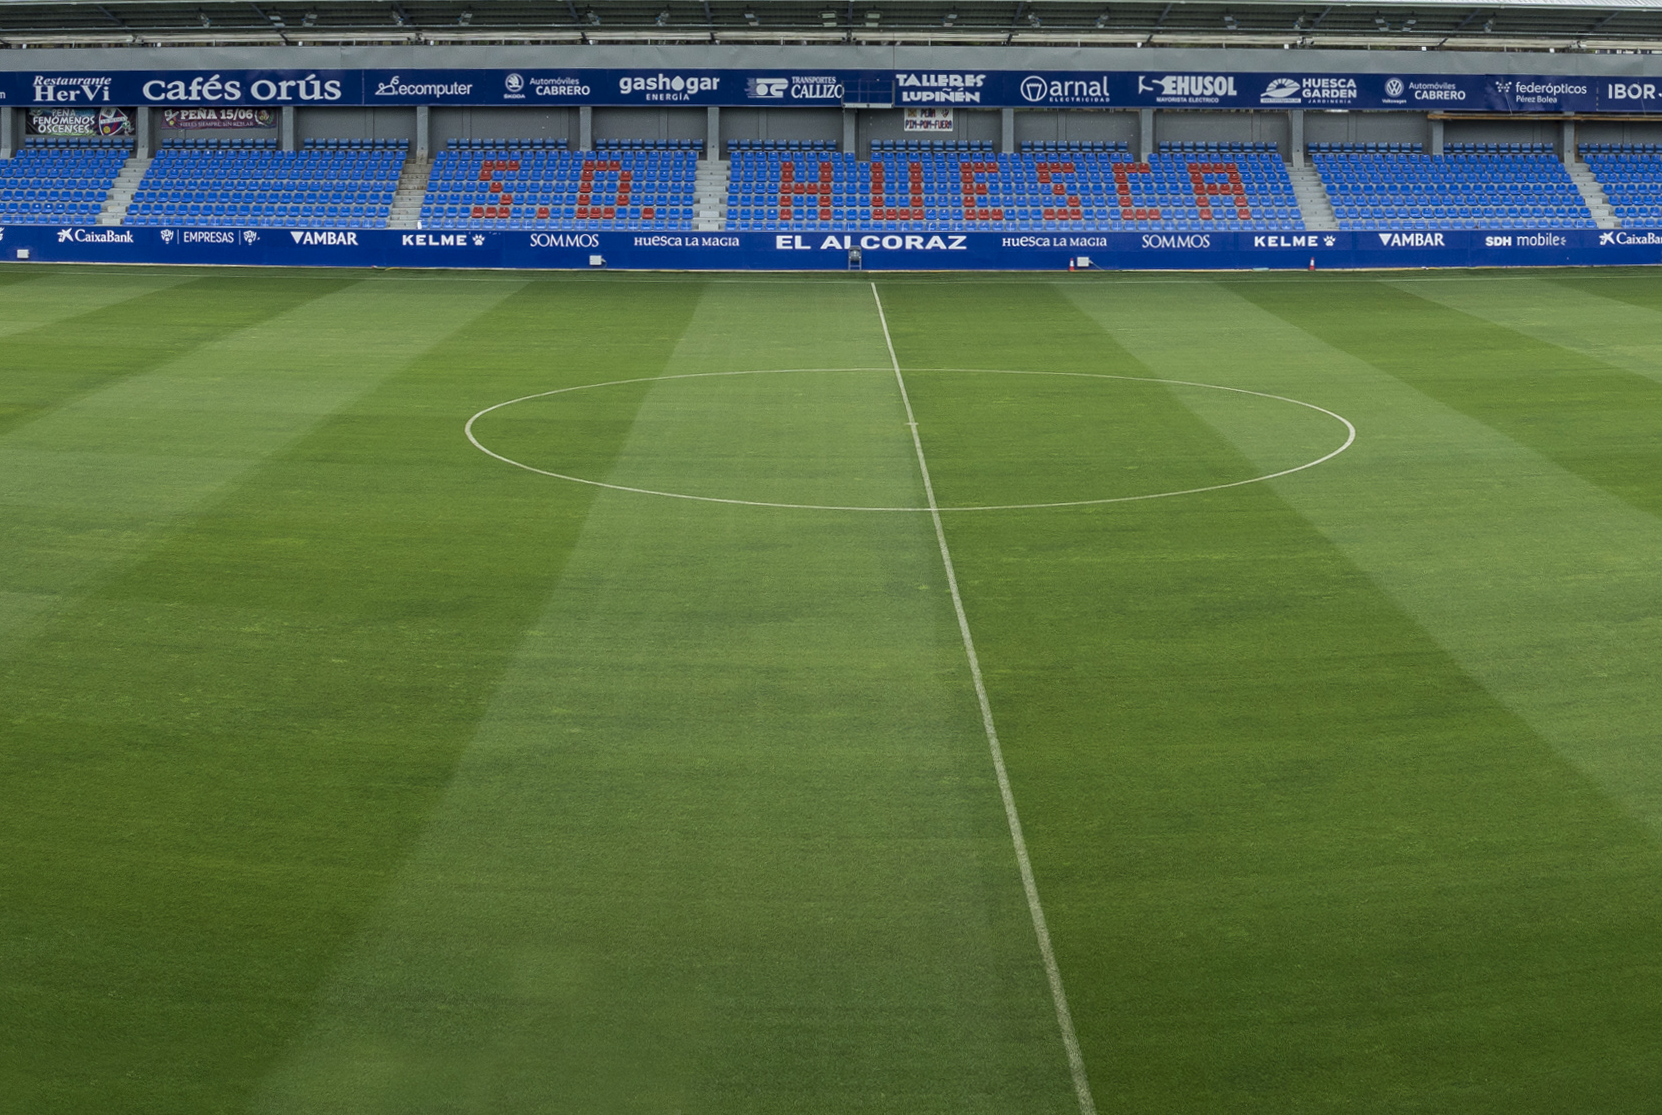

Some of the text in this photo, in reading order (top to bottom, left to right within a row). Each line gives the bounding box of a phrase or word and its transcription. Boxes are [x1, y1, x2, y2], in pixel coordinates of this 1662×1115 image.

[33, 75, 112, 86] Restaurante
[530, 77, 579, 86] Automóviles
[895, 73, 986, 87] TALLERES
[1049, 76, 1109, 96] arnal
[1302, 78, 1356, 88] HUESCA
[1409, 81, 1456, 90] Automóviles
[34, 85, 110, 102] HerVi
[142, 74, 342, 101] cafés orús
[536, 86, 591, 96] CABRERO
[791, 84, 845, 99] CALLIZO
[1302, 88, 1357, 98] GARDEN
[1515, 81, 1587, 95] federópticos
[1608, 83, 1655, 99] IBOR
[646, 92, 690, 101] ENERGÍA
[902, 87, 980, 102] LUPIÑÉN
[1414, 90, 1466, 100] CABRERO
[1516, 94, 1557, 103] Pérez Bolea
[180, 108, 253, 121] PEÑA 15/06
[780, 161, 1249, 220] HUESCA
[74, 229, 134, 243] CaixaBank
[184, 231, 234, 243] EMPRESAS
[303, 232, 358, 246] AMBAR
[402, 235, 467, 246] KELME
[531, 234, 599, 247] SOMMOS
[776, 235, 967, 249] EL ALCORAZ
[1142, 234, 1210, 248] SOMMOS
[1254, 236, 1318, 247] KELME
[1391, 233, 1445, 246] AMBAR
[1485, 233, 1558, 246] SDH mobile
